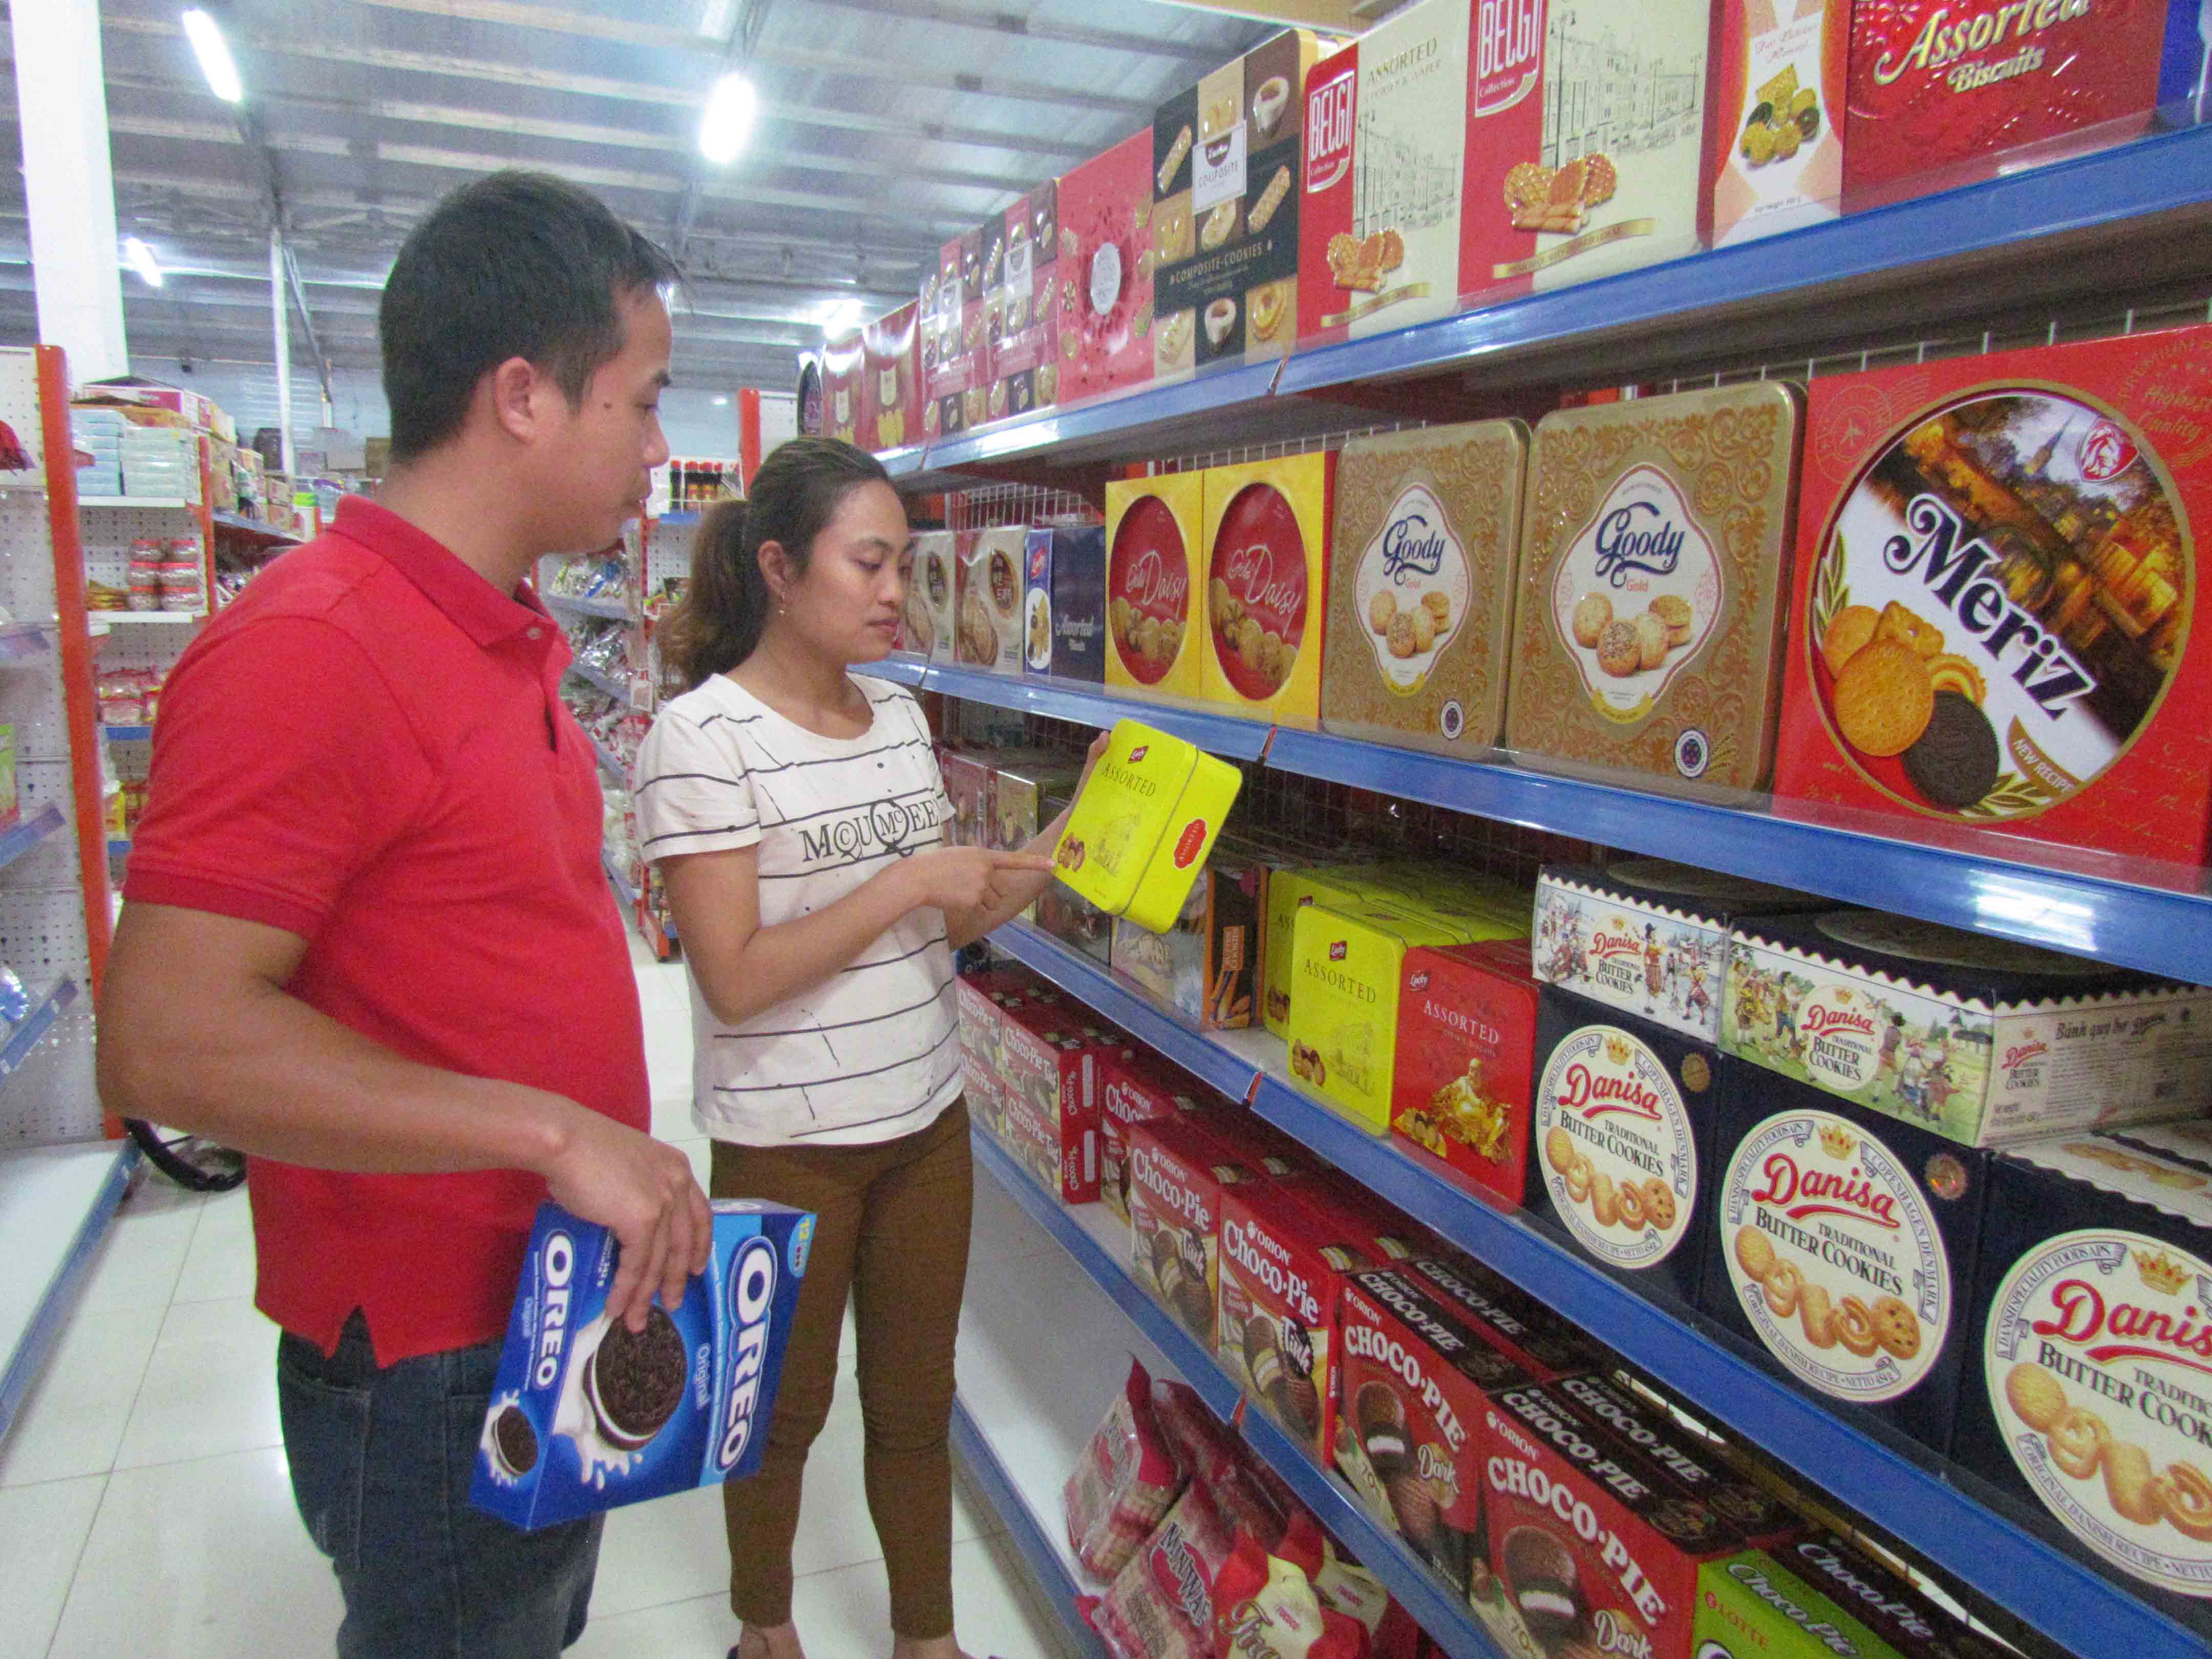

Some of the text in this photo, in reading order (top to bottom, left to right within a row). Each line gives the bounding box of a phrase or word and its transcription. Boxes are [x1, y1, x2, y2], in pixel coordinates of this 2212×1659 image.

[1368, 37, 1437, 87] ASSORTED
[1947, 45, 2045, 93] Biscuits
[1310, 79, 1352, 162] BELGI
[1384, 514, 1445, 585] Goody
[1596, 502, 1685, 587] Goody
[1139, 549, 1187, 620] Daisy
[1245, 544, 1302, 639] Daisy
[1102, 762, 1156, 797] ASSORTED
[2013, 737, 2075, 794] NEW RECIPE
[1589, 932, 1642, 959] Danisa
[1599, 959, 1632, 982] BUTTER
[1303, 959, 1376, 1003] ASSORTED
[1596, 972, 1633, 995] COOKIES
[1423, 1000, 1499, 1044] ASSORTED
[1801, 1004, 1875, 1037] Danisa
[1809, 1050, 1861, 1081] COOKIES
[1813, 1036, 1860, 1066] BUTTER
[1558, 1063, 1663, 1120] Danisa
[1561, 1110, 1664, 1178] BUTTER COOKIES
[1604, 1119, 1660, 1156] TRADITIONAL
[1160, 1154, 1186, 1183] ORION
[1751, 1153, 1900, 1229] Danisa
[1257, 1230, 1291, 1266] ORION
[1756, 1206, 1903, 1297] BUTTER COOKIES
[1818, 1221, 1897, 1271] TRADITIONAL
[537, 1235, 573, 1386] OREO
[1353, 1296, 1381, 1327] ORION
[694, 1343, 712, 1410] Original
[721, 1247, 772, 1467] OREO
[2038, 1340, 2134, 1409] BUTTER
[1499, 1423, 1539, 1461] ORION
[1418, 1444, 1460, 1494] Dark
[1729, 1564, 1860, 1657] Choco Pie
[1797, 1543, 1934, 1639] Choco Pie
[1594, 1610, 1653, 1659] Dark
[1718, 1604, 1770, 1652] LOTTE
